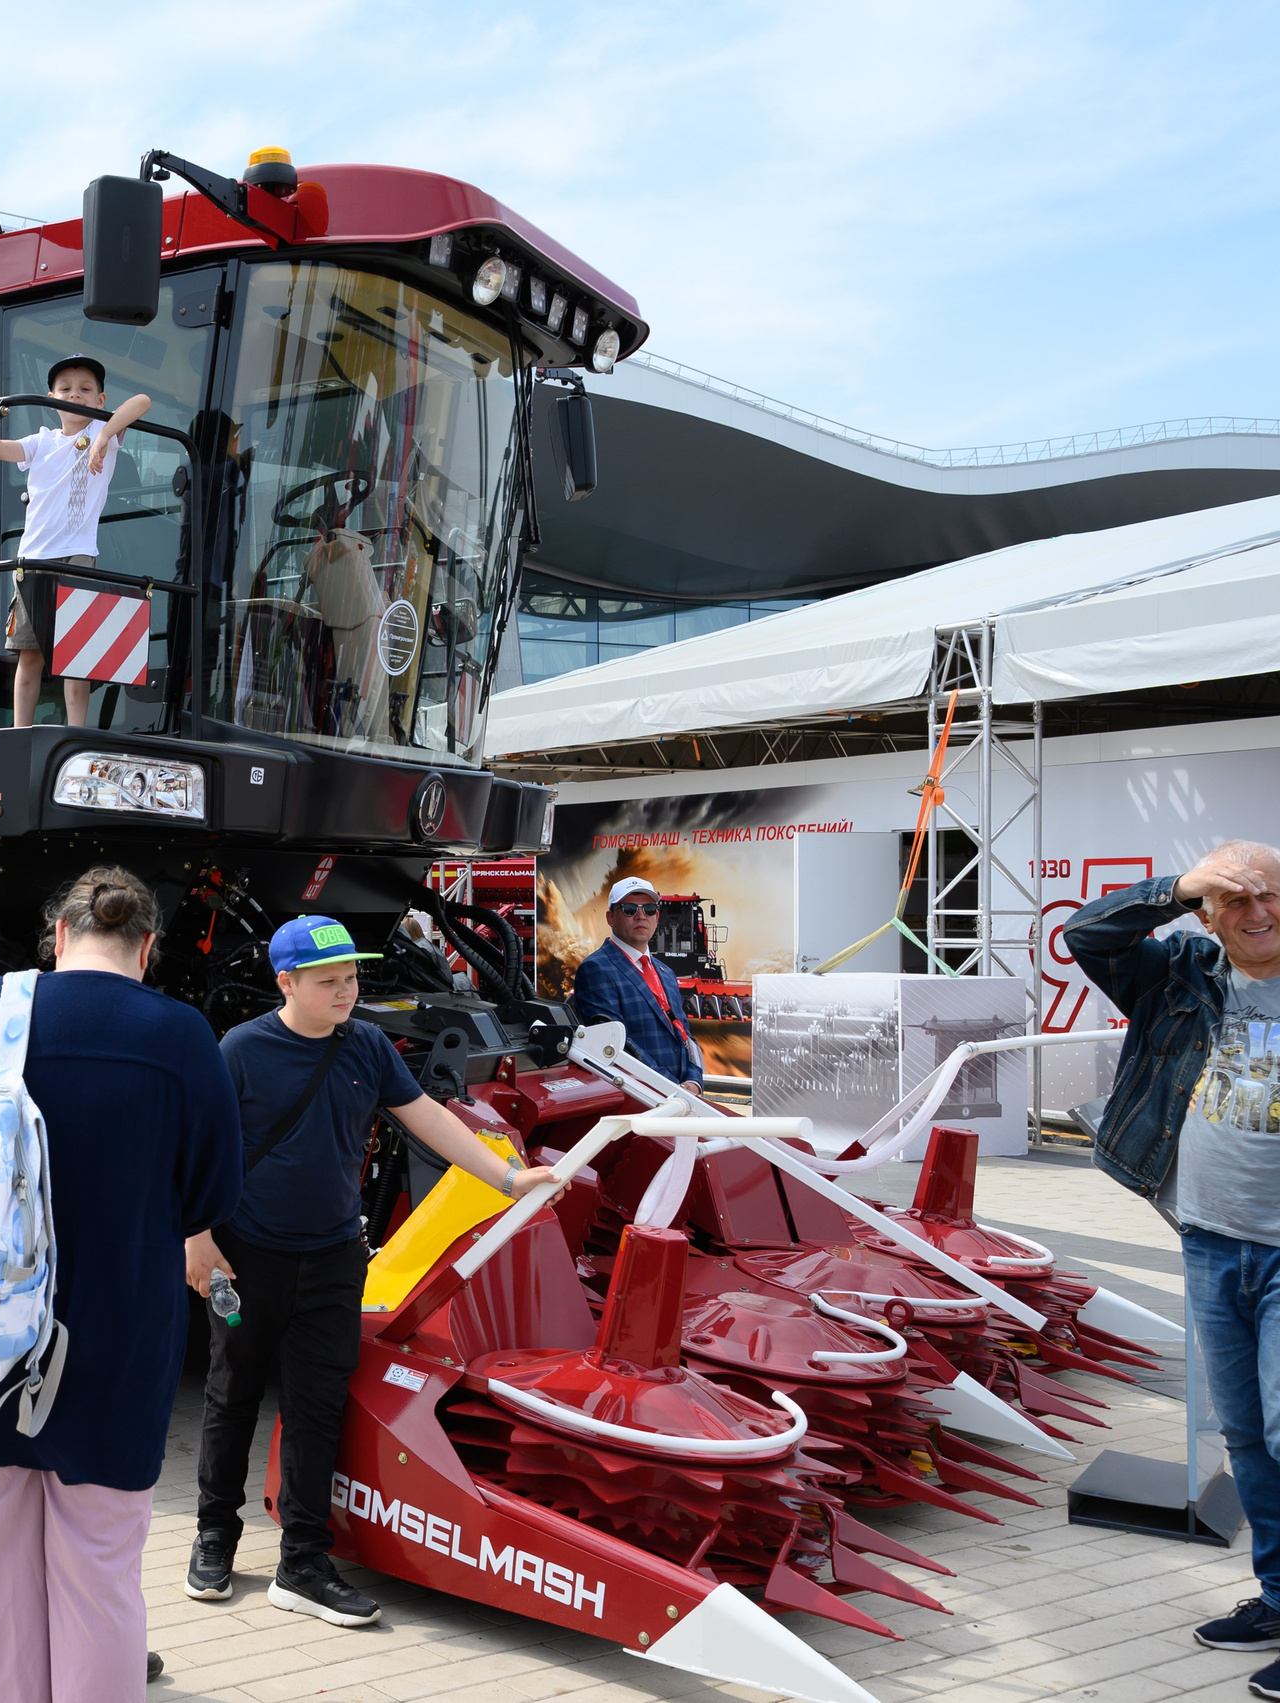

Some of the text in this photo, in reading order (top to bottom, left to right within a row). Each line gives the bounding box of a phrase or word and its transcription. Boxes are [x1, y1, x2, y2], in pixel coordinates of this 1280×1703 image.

[592, 831, 681, 849] ГОМСЕЛЬМАШ
[692, 827, 751, 845] ТЕХНИКА
[330, 1471, 606, 1619] GOMSELMASH
